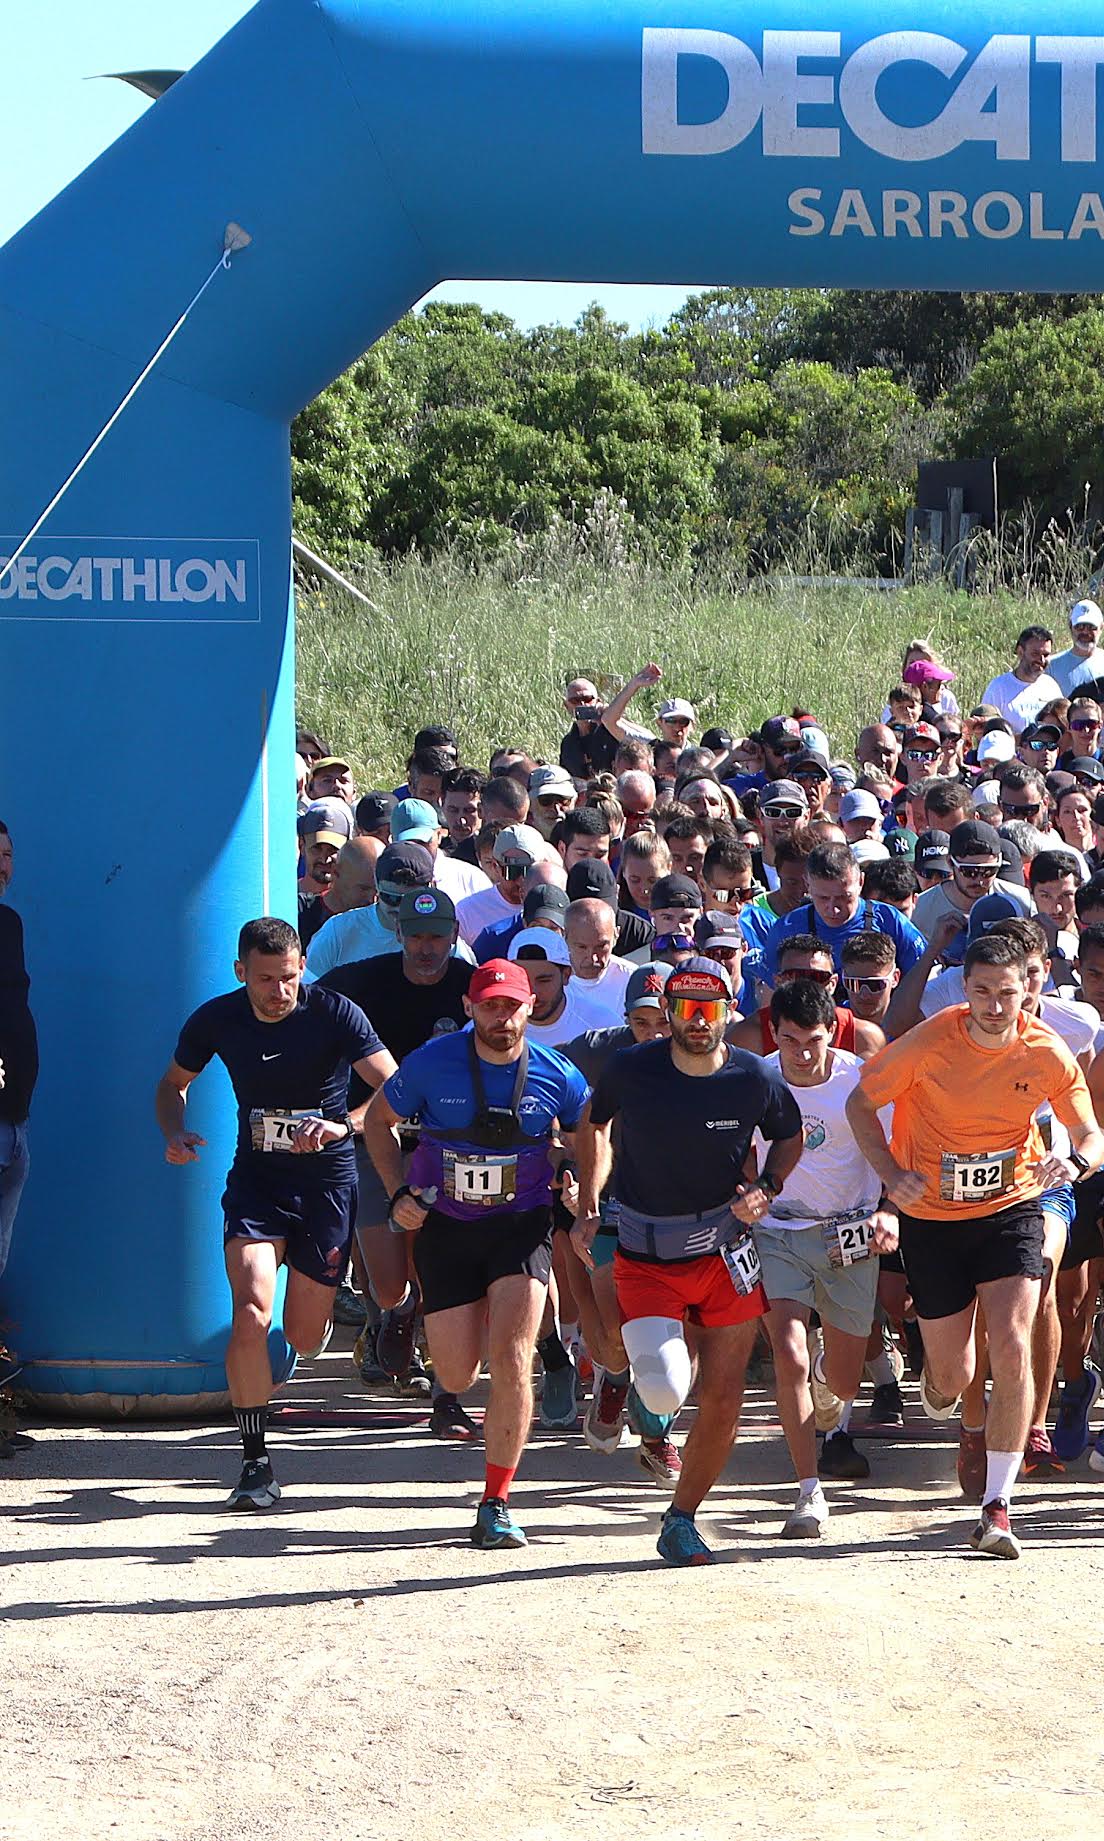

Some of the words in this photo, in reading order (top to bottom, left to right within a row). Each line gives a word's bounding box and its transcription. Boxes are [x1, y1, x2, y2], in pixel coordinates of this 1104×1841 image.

[922, 846, 948, 857] HOKA
[464, 1170, 489, 1190] 11
[958, 1165, 1000, 1187] 182
